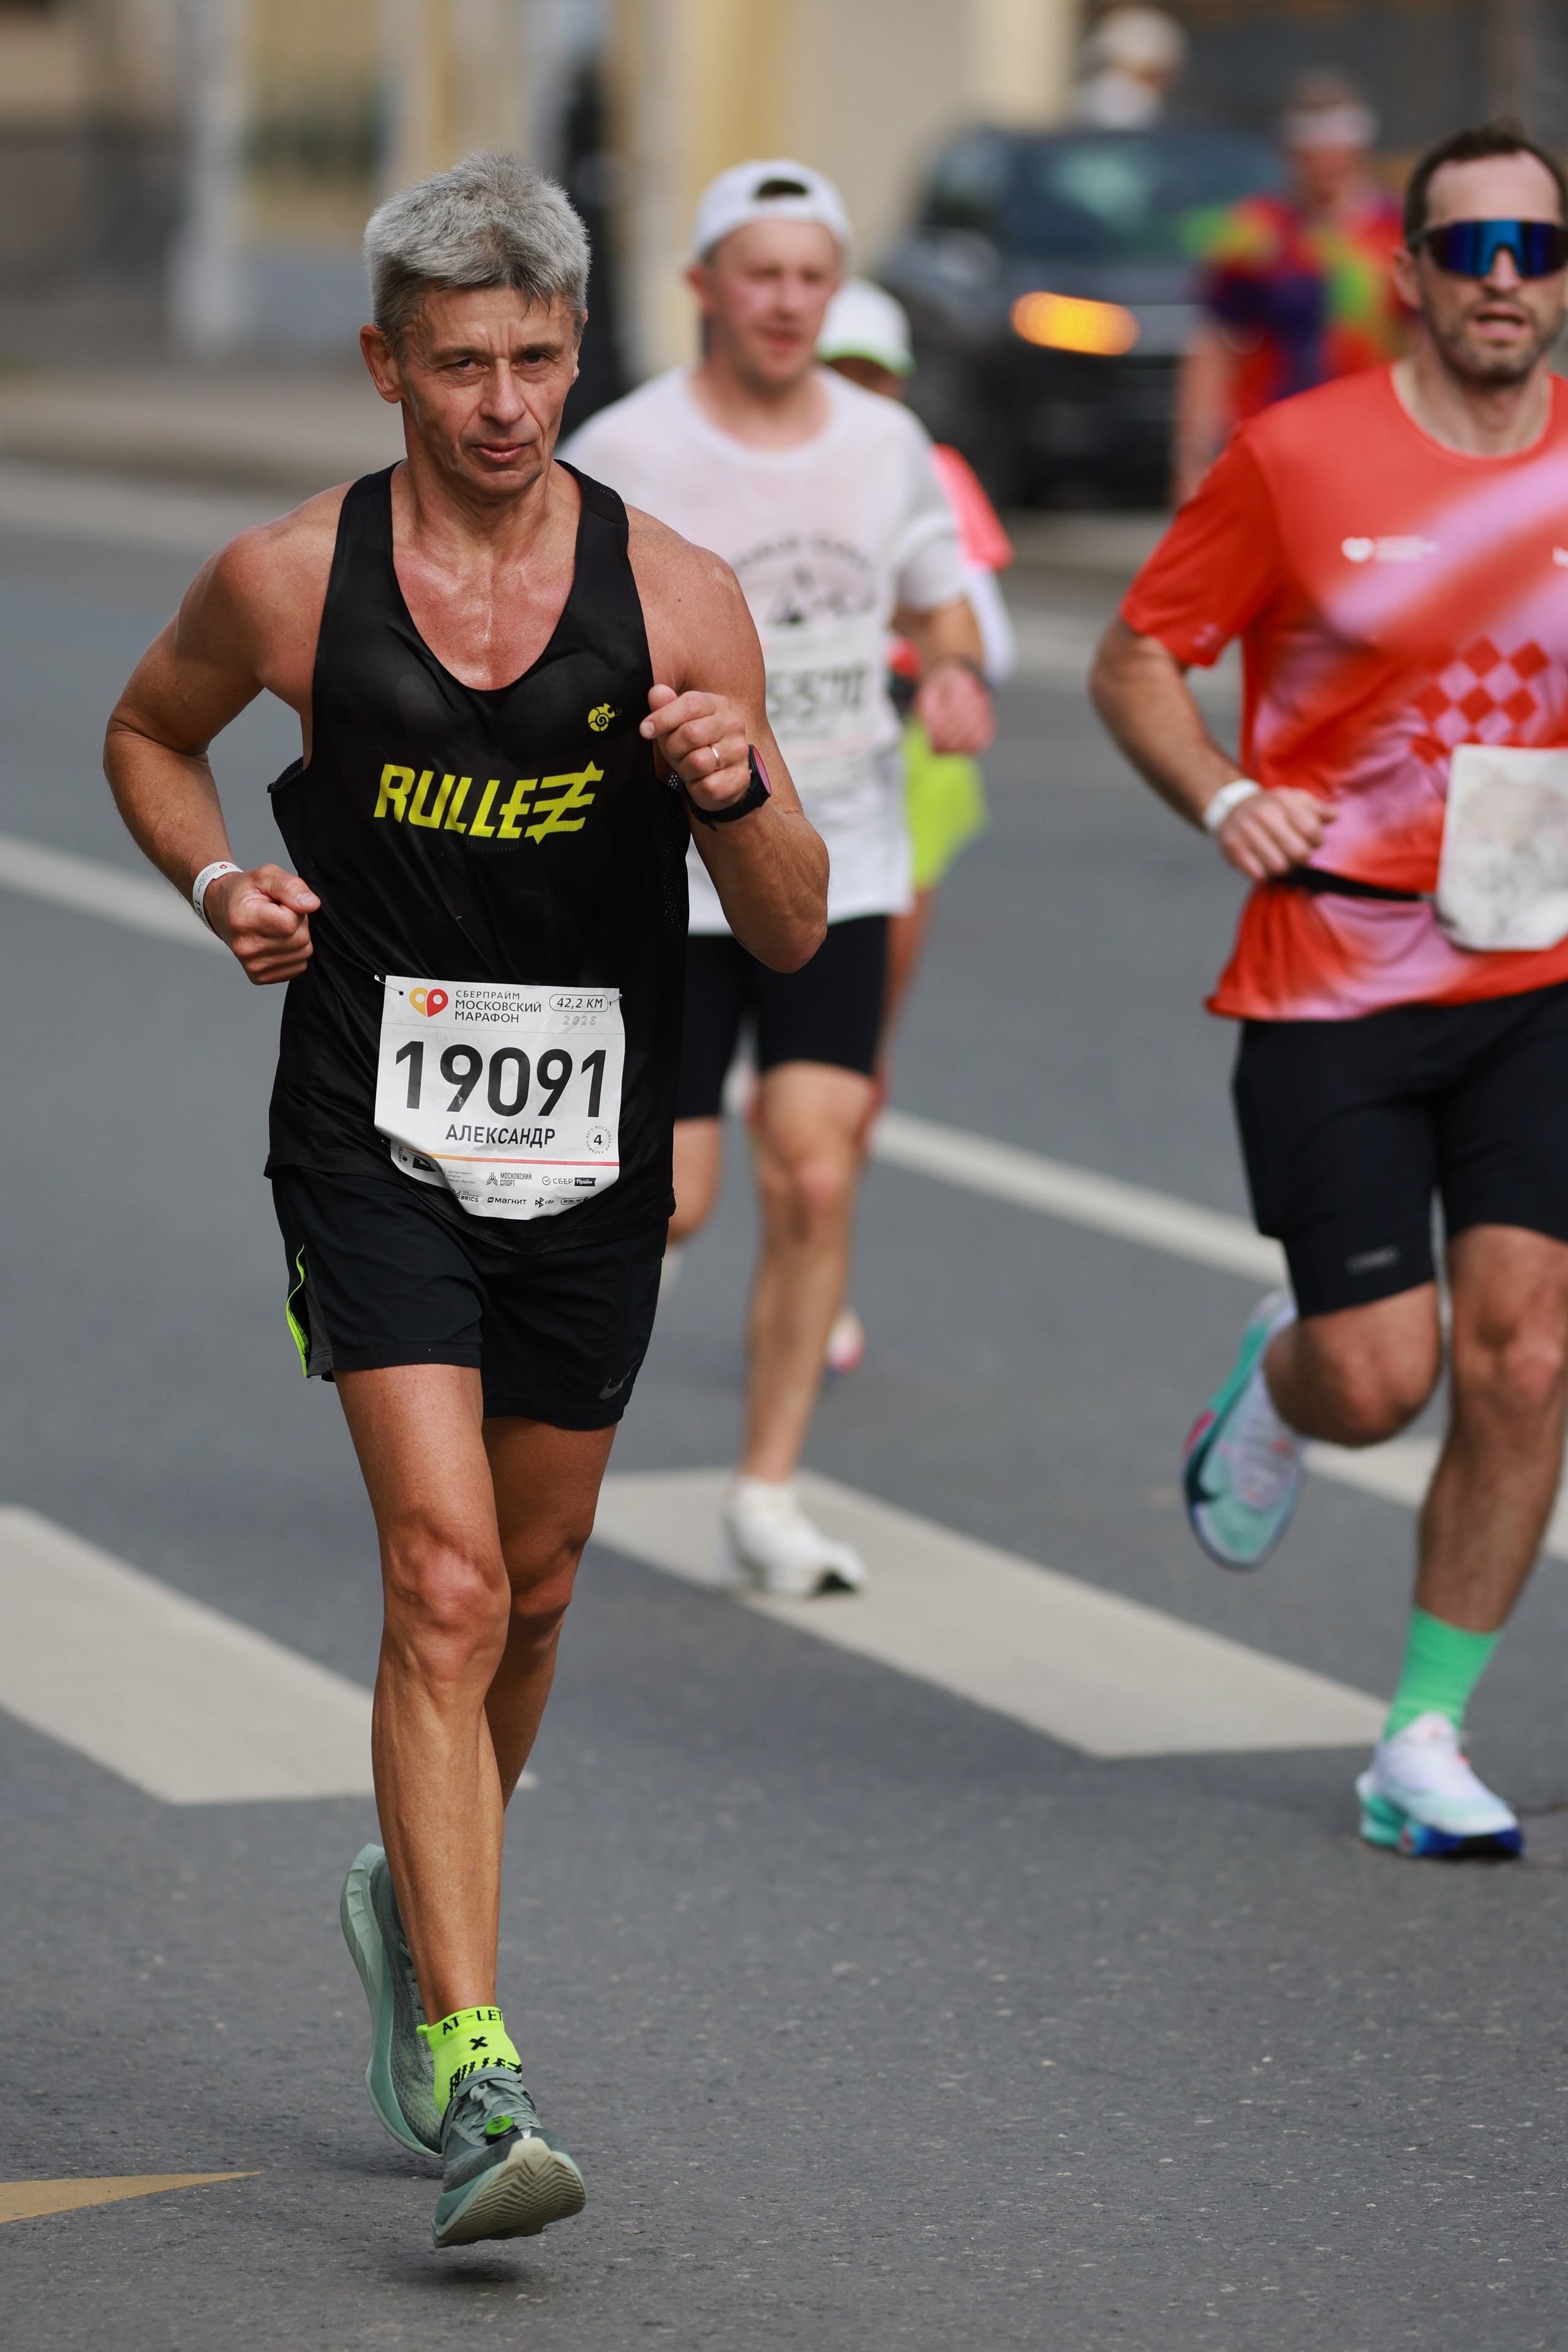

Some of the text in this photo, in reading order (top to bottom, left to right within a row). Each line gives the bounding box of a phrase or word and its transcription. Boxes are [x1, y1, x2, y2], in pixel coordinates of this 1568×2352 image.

[374, 760, 604, 845] RULLEZ
[456, 990, 520, 1000] СБЕРПРАЙМ
[456, 1000, 541, 1012] МОСКОВСКИЙ
[557, 998, 582, 1008] 42,2
[454, 1011, 519, 1023] МАРАФОН
[562, 1015, 597, 1026] 2026
[395, 1041, 606, 1118] 19091
[445, 1124, 556, 1148] АЛЕКСАНДР
[594, 1134, 603, 1145] 4
[500, 1172, 532, 1180] МОСКОВСКИЙ
